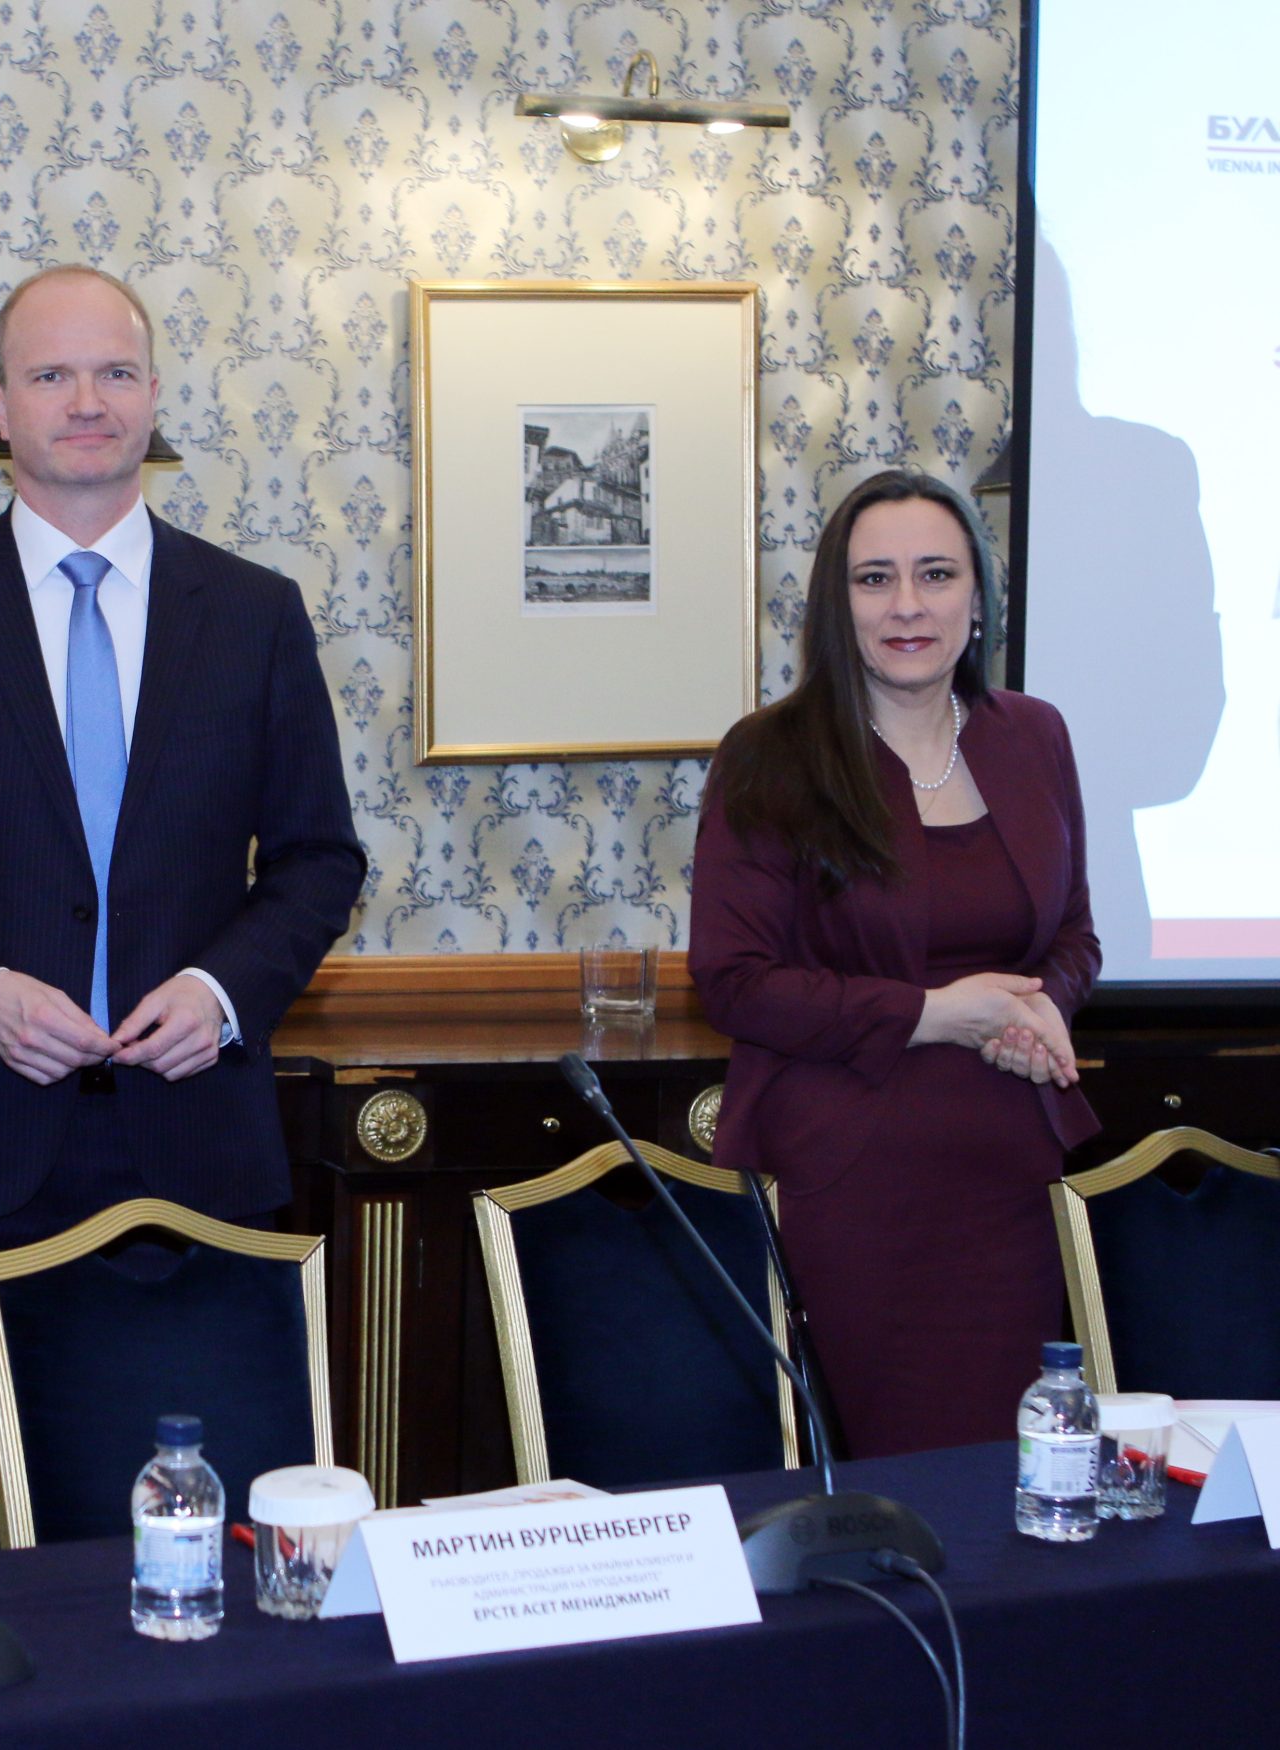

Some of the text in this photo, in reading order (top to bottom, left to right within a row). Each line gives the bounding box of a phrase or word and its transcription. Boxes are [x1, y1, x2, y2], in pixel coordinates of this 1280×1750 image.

[1207, 158, 1263, 174] VIENNA
[412, 1512, 692, 1559] МАРТИН ВУРЦЕНБЕРГЕР
[473, 1588, 671, 1622] ЕРСТЕ АСЕТ МЕНИДЖМЪНТ
